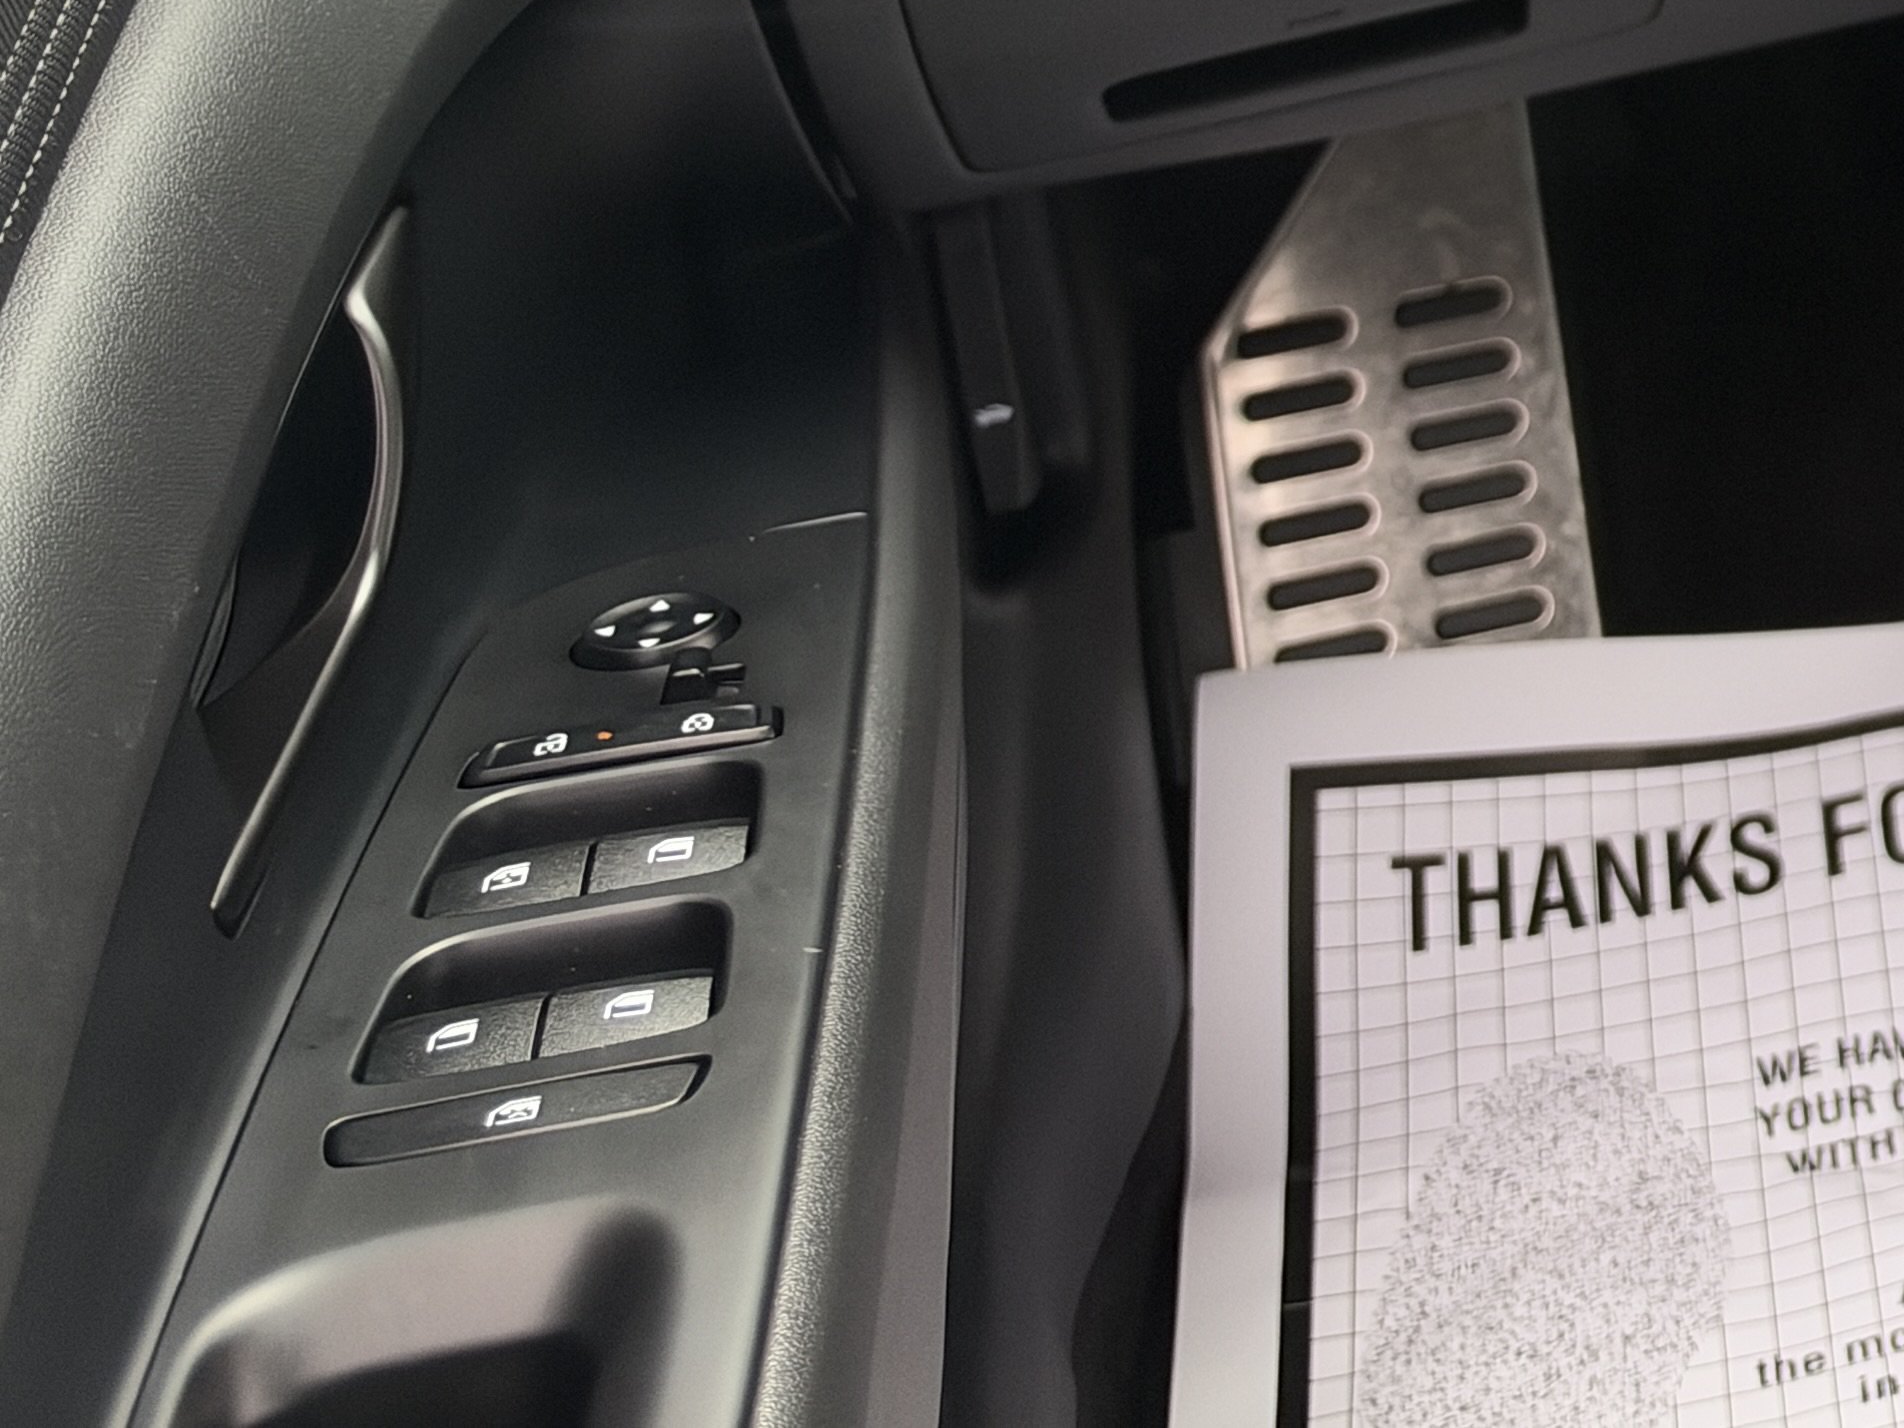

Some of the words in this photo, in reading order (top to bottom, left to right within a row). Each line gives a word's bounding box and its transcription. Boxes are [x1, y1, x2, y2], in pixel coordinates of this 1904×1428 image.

[1391, 810, 1785, 952] THANKS
[1756, 1041, 1822, 1088] WE
[1754, 1083, 1875, 1138] YOUR
[1786, 1127, 1898, 1175] WITH
[1756, 1345, 1828, 1388] the
[1857, 1372, 1901, 1404] in
